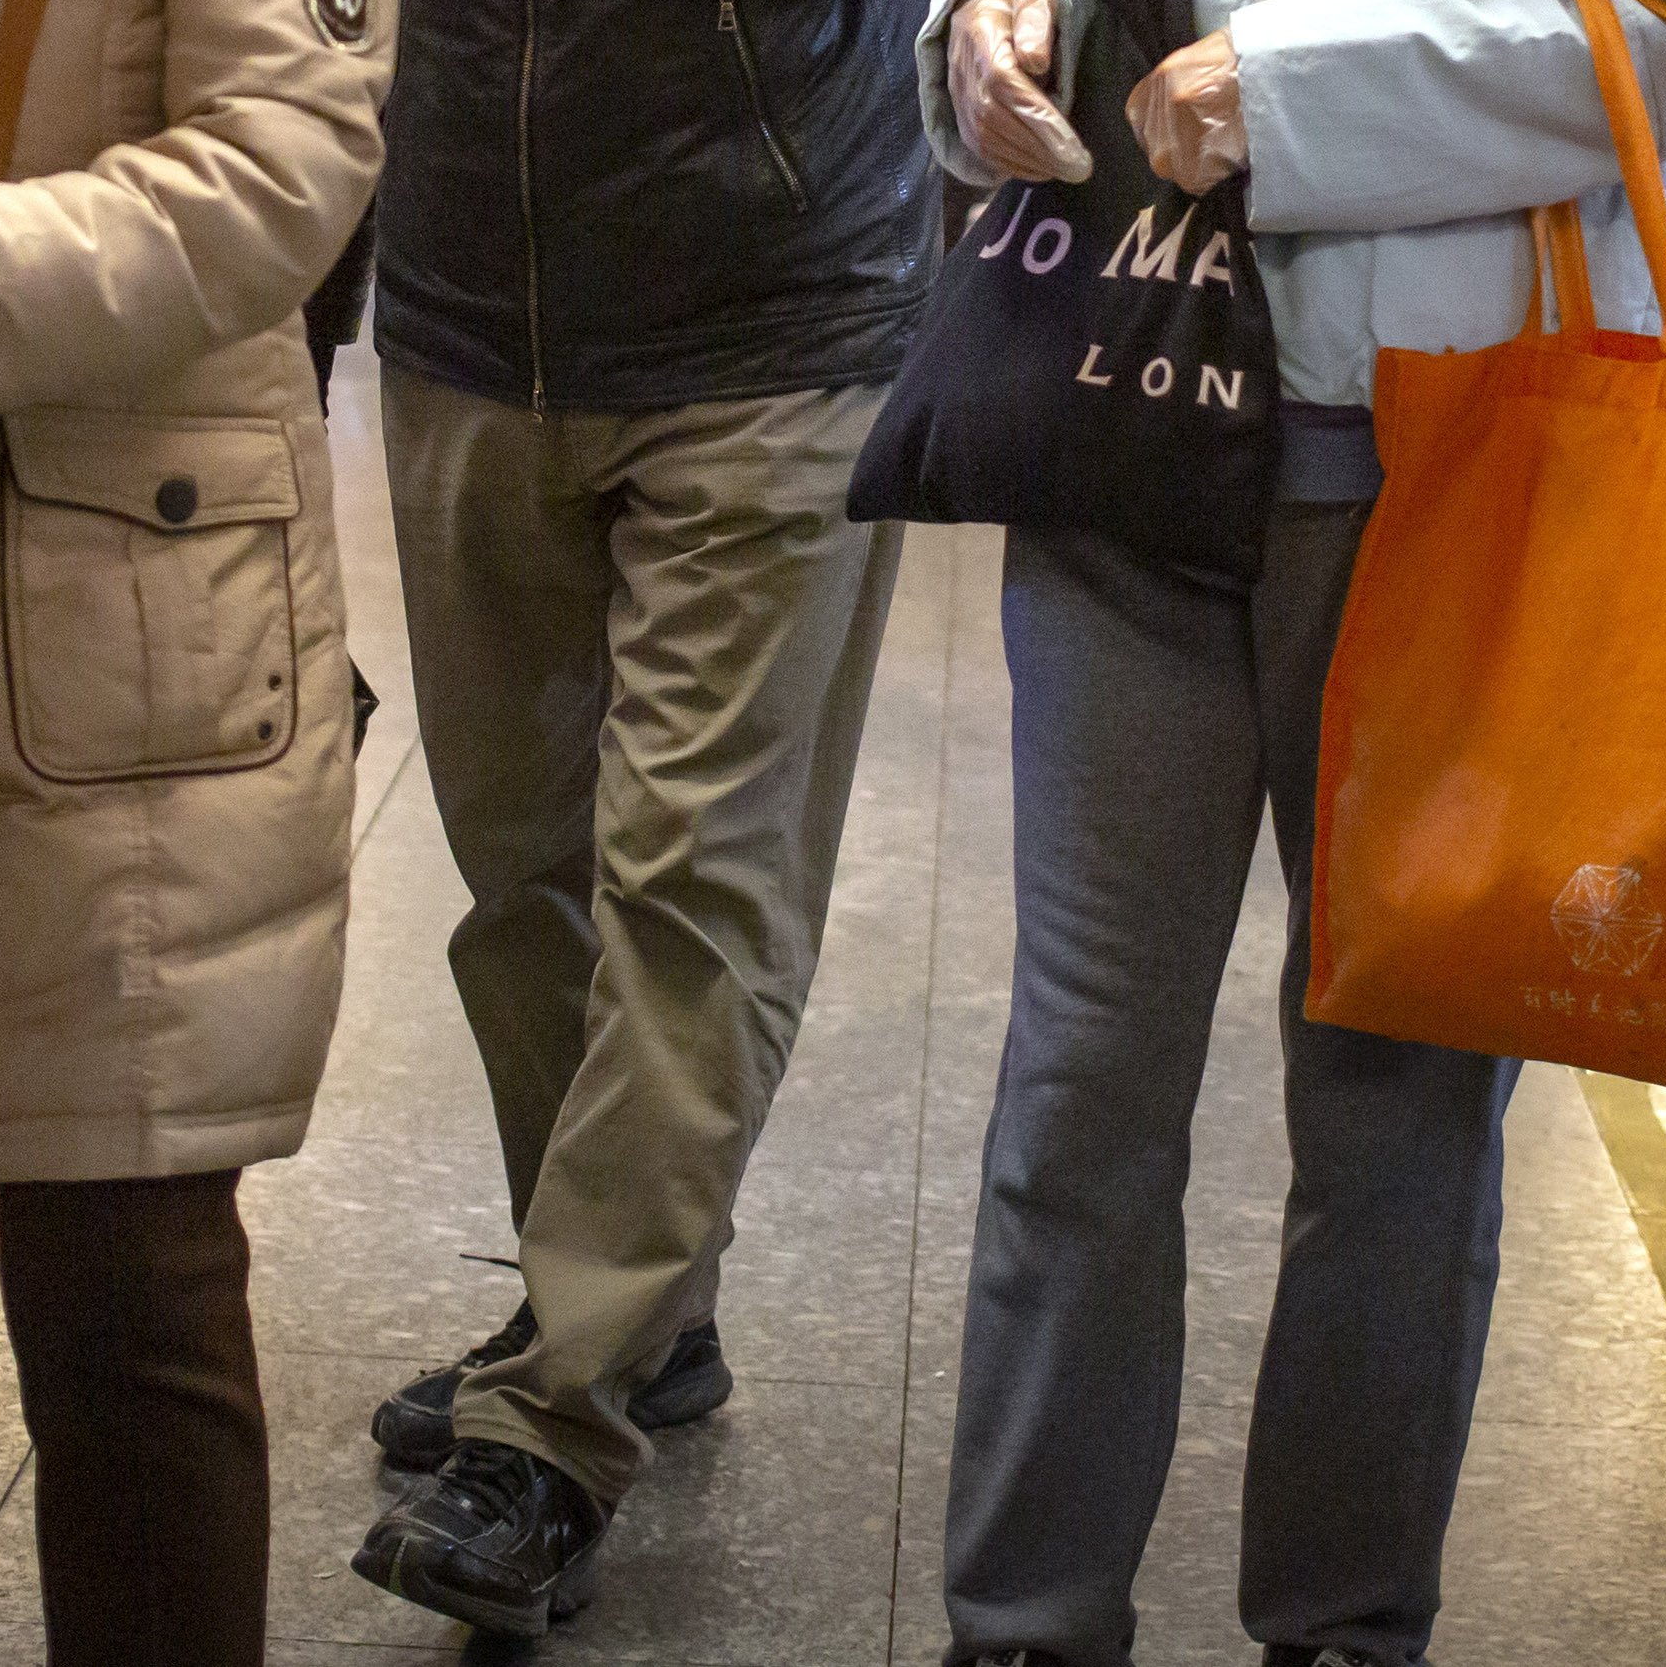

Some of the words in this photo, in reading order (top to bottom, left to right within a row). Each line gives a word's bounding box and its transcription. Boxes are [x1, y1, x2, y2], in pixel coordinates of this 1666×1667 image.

[978, 187, 1072, 275] JO
[1099, 202, 1235, 298] MA
[1075, 343, 1245, 410] LON
